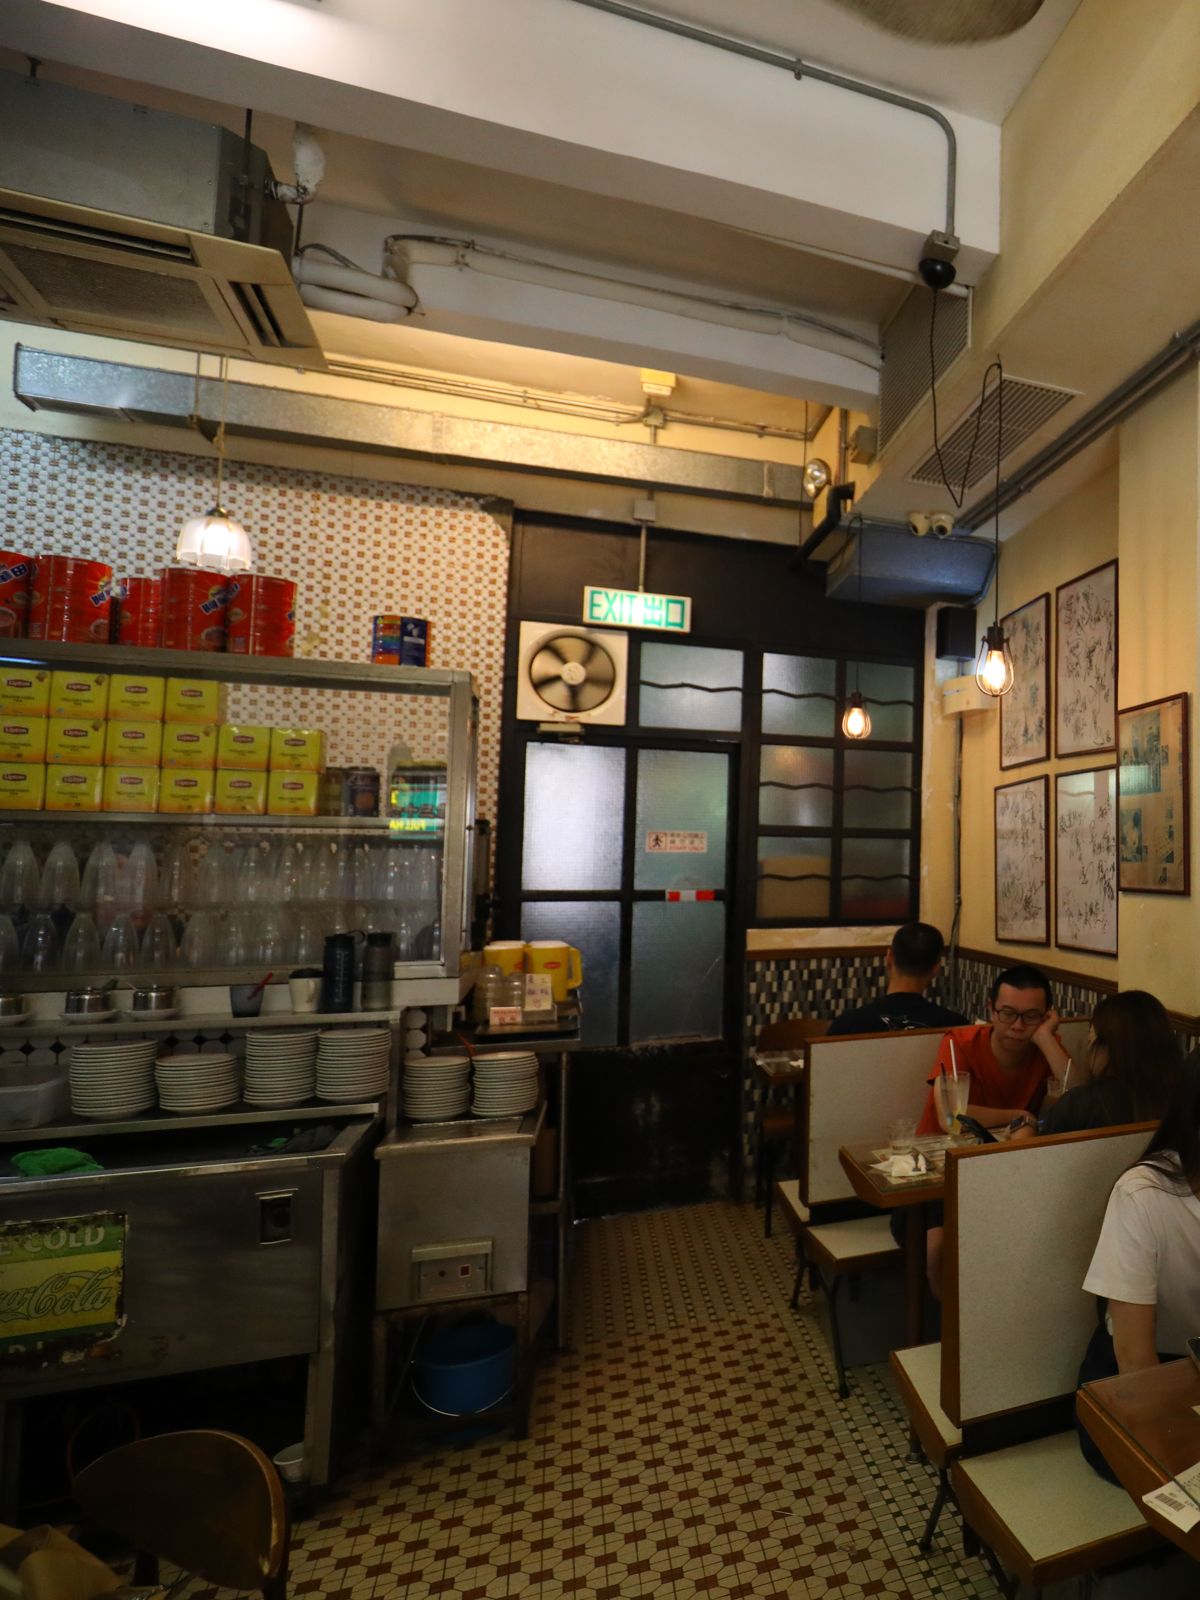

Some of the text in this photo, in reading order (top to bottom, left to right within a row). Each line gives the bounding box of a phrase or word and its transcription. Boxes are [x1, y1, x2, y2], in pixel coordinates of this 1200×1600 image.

[589, 590, 637, 624] EXIT
[643, 596, 686, 630] 出口
[23, 1225, 106, 1252] COLD
